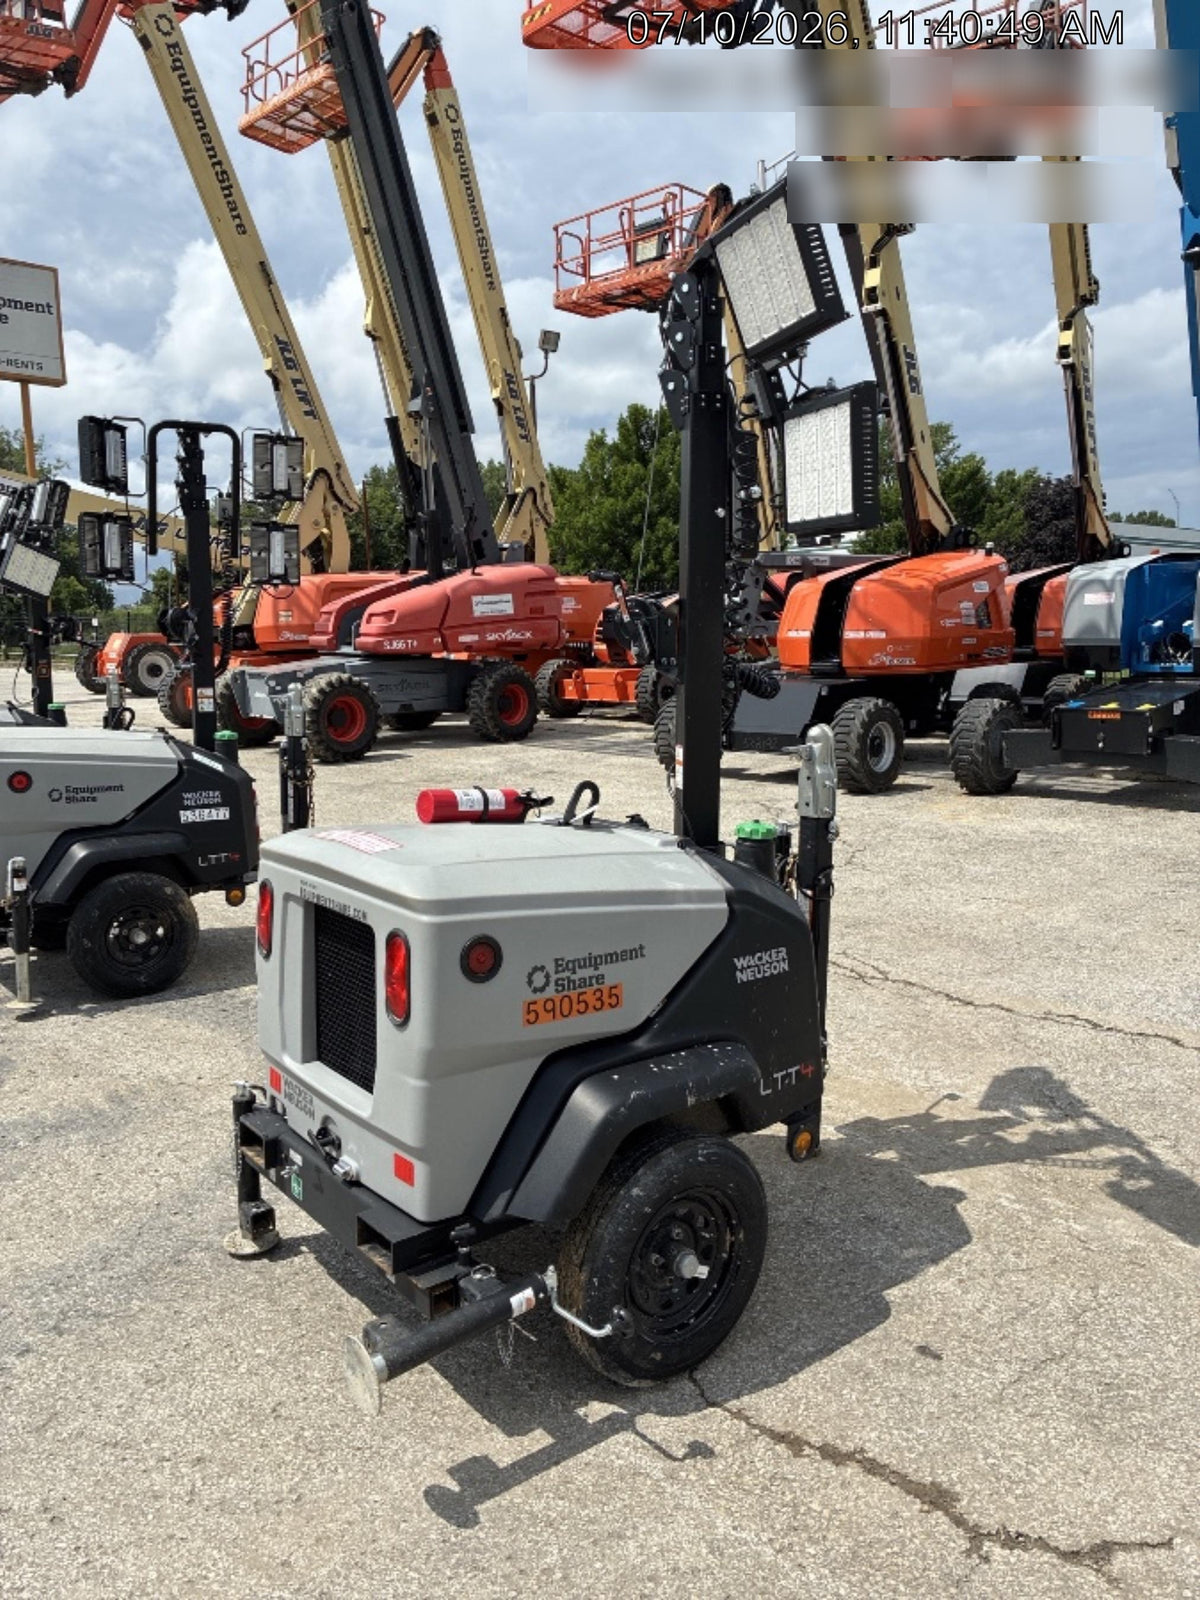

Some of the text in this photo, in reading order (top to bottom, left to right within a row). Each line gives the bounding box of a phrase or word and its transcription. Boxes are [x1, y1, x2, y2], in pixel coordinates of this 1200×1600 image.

[165, 41, 247, 236] EquipmentShare
[451, 127, 496, 291] EquipmentShare
[291, 378, 319, 420] LIFT
[512, 405, 532, 443] LIFT
[65, 784, 124, 797] Equipment
[65, 795, 98, 804] Share
[554, 944, 646, 975] Equipment
[734, 947, 788, 970] WACKER
[736, 960, 789, 984] NEUSON
[554, 973, 605, 994] Share
[526, 985, 620, 1025] 590535
[760, 1063, 814, 1095] LTT4
